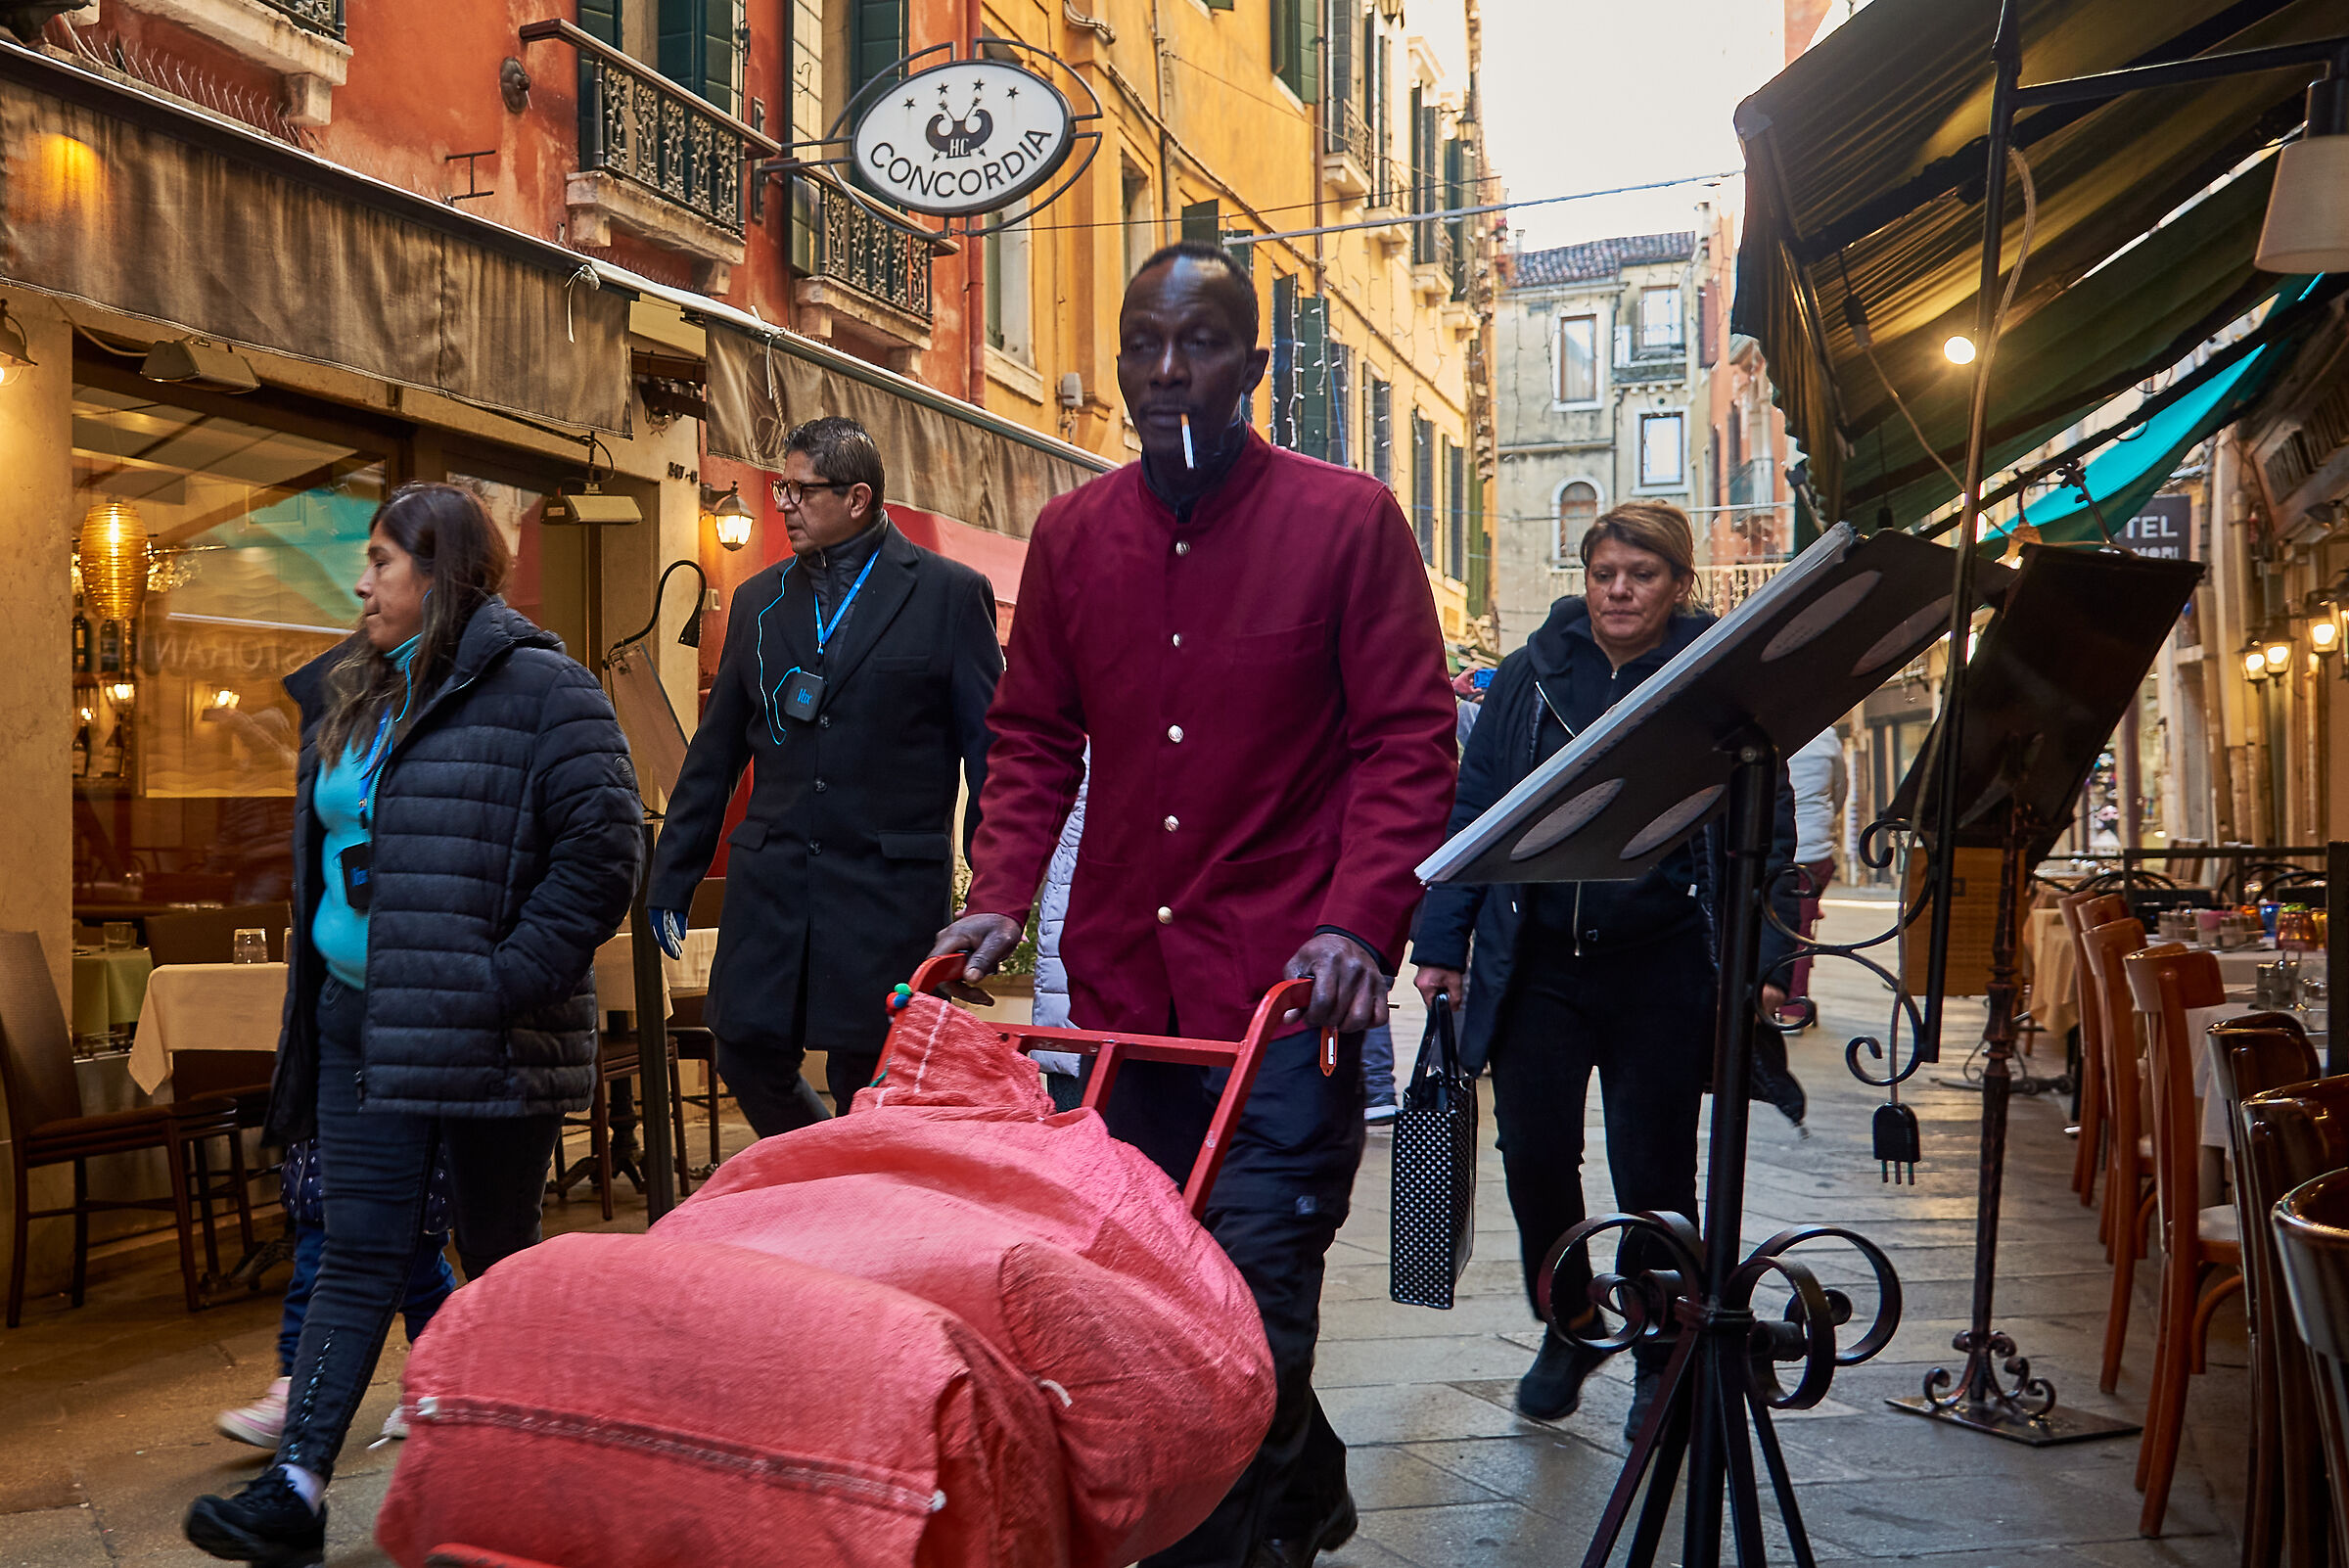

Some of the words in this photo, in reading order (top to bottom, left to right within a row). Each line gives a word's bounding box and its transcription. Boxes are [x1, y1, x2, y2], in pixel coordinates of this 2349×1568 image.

[948, 137, 970, 158] HC
[869, 128, 1053, 199] CONCORDIA
[2114, 515, 2179, 539] TEL
